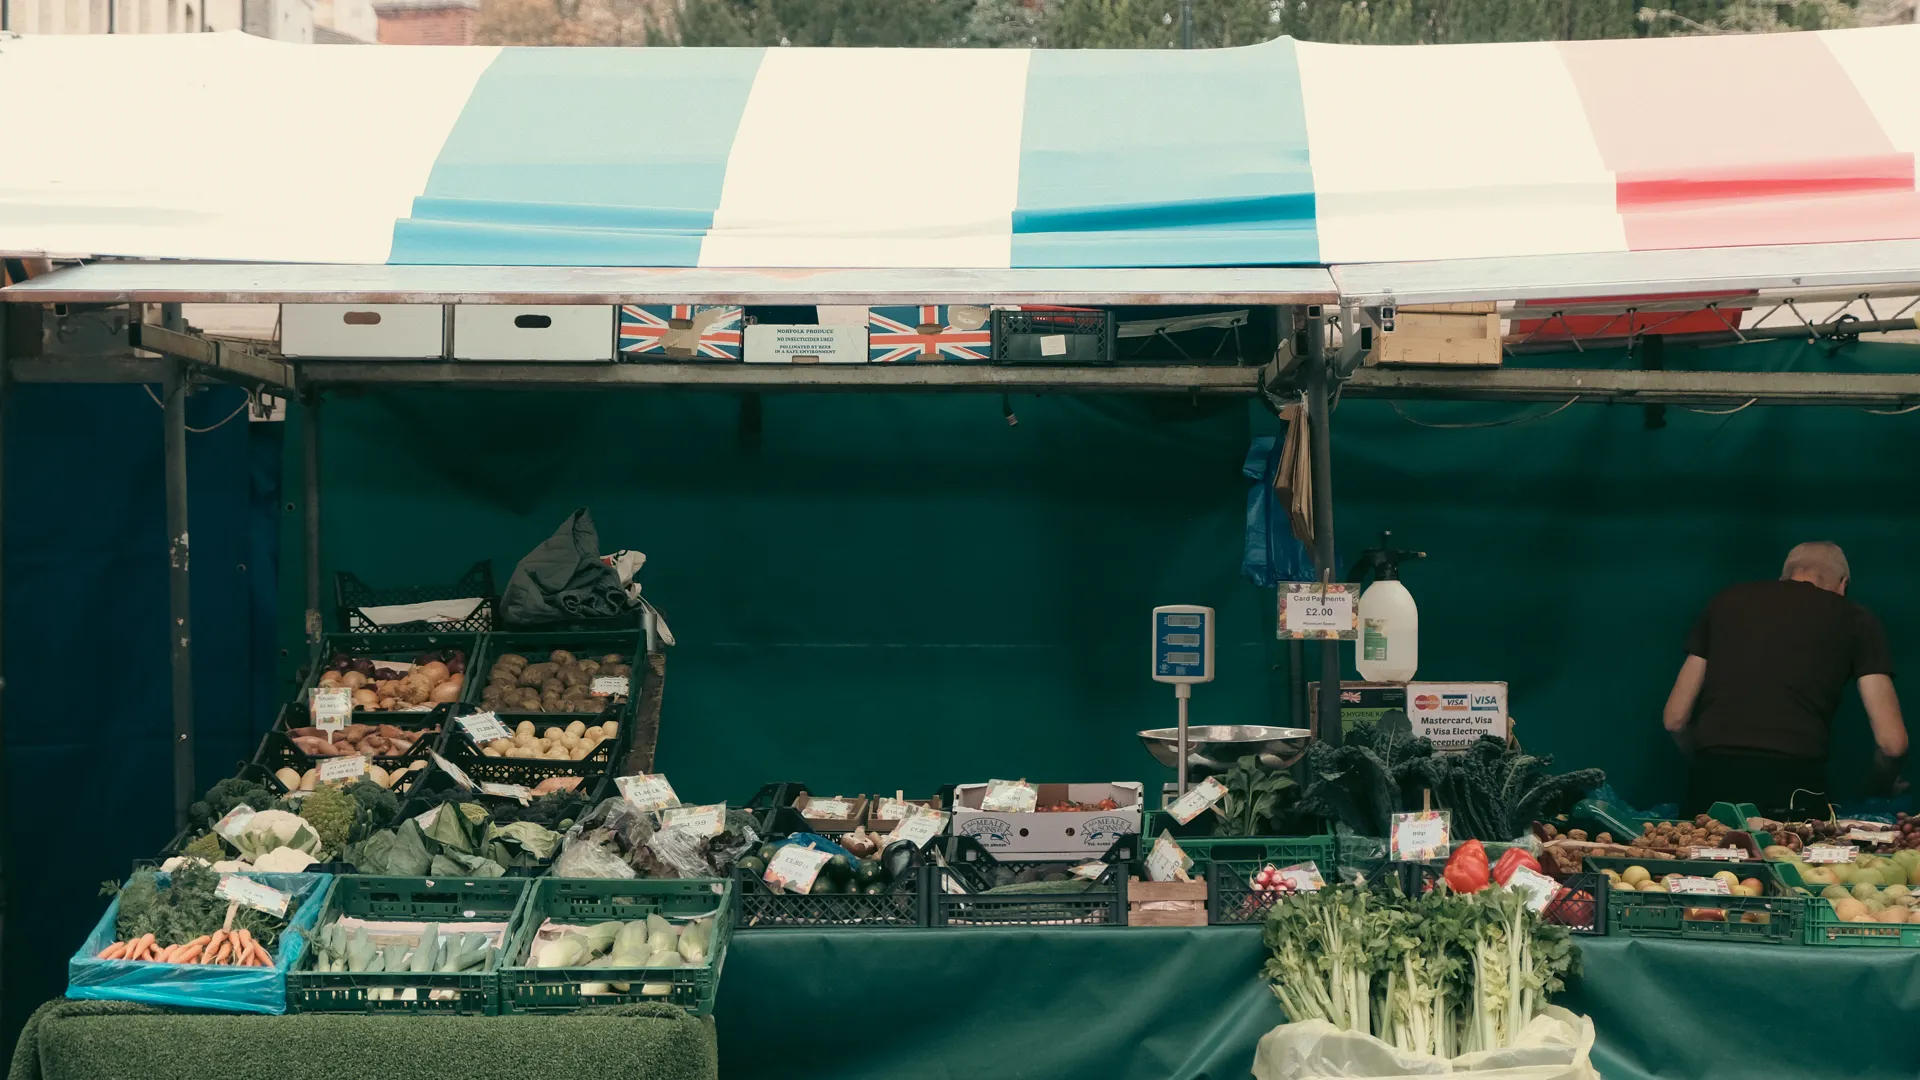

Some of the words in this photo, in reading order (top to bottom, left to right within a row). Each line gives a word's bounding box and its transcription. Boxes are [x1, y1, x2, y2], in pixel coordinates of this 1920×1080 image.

[1305, 608, 1333, 617] £2.00
[1474, 695, 1497, 704] VISA
[1421, 717, 1473, 725] Mastercard,
[1433, 727, 1451, 735] Visa
[1432, 739, 1468, 747] ccepted
[976, 819, 1004, 827] MEALE
[1097, 818, 1126, 826] MEALE
[976, 825, 997, 833] SONS
[1097, 824, 1119, 832] SONS
